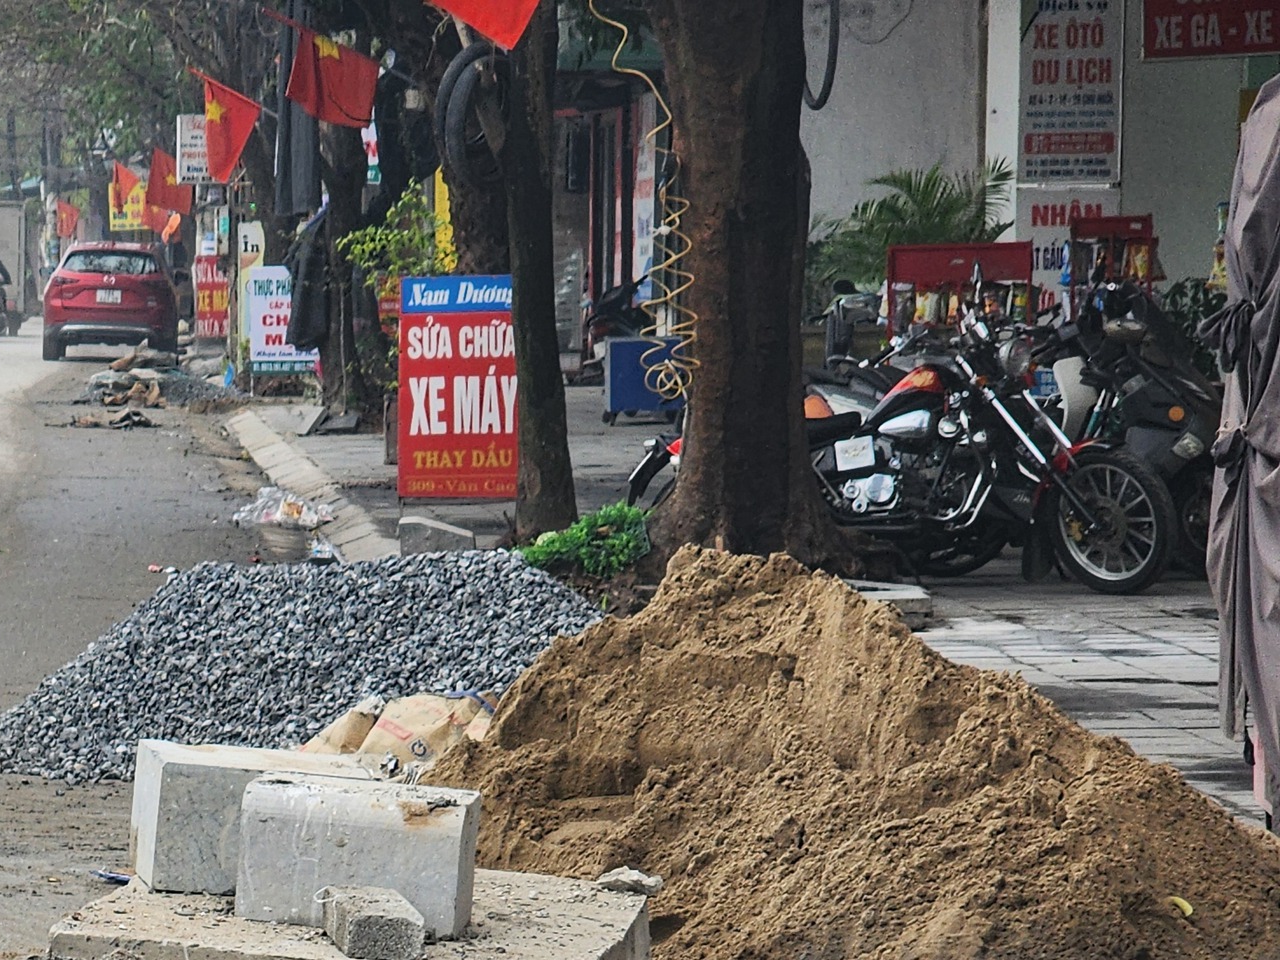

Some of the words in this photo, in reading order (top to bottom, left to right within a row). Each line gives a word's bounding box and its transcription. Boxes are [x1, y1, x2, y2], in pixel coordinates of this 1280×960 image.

[1033, 22, 1059, 49] XE
[1065, 16, 1104, 49] ÔTÔ
[1154, 16, 1184, 50] XE
[1191, 13, 1222, 48] GA
[1244, 9, 1274, 46] XE
[1032, 59, 1060, 85] DU
[1066, 57, 1112, 89] LỊCH
[409, 282, 450, 306] Nam
[407, 316, 453, 360] SỬA
[458, 319, 516, 359] CHỮA
[408, 376, 448, 436] XE
[453, 365, 518, 435] MÁY
[412, 449, 466, 470] THAY
